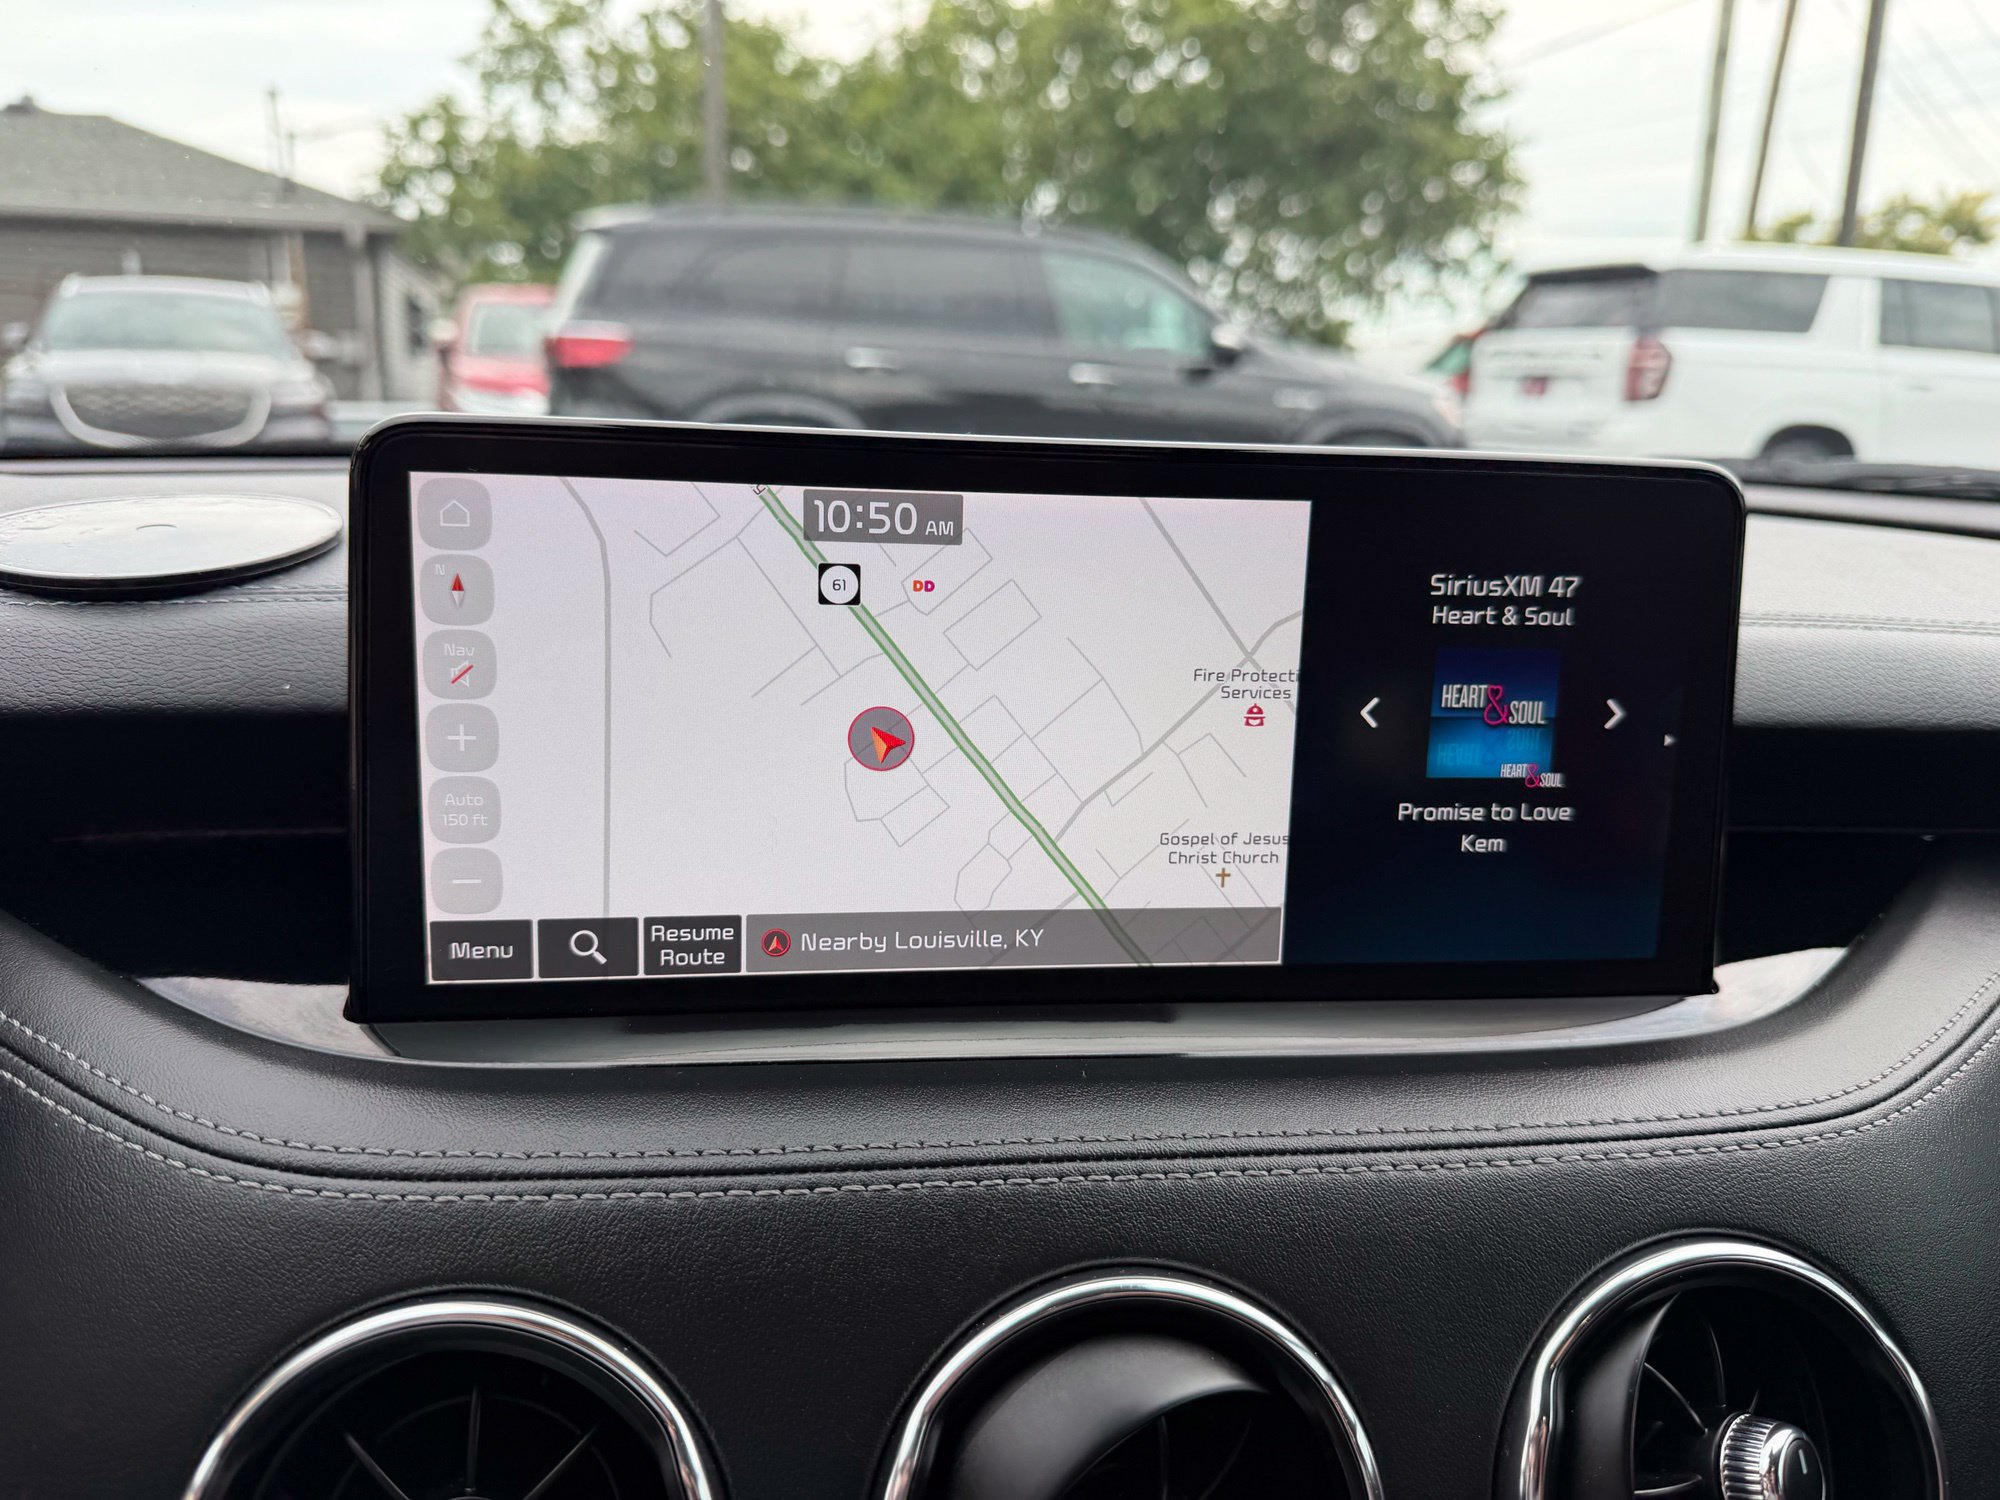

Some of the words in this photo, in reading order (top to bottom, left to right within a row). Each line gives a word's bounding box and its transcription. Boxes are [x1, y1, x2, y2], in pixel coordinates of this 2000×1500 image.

[813, 499, 918, 535] 10:50
[925, 520, 954, 536] AM
[435, 564, 446, 576] N
[832, 578, 846, 591] 61
[912, 579, 936, 593] DD
[1430, 573, 1545, 598] SiriusXM
[1547, 575, 1583, 599] 47
[1431, 604, 1499, 626] Heart
[1501, 605, 1519, 626] &
[1523, 606, 1577, 627] Soul
[444, 643, 475, 656] Nav
[1193, 668, 1226, 683] Fire
[1220, 685, 1292, 700] Services
[1441, 684, 1488, 709] HEART
[1482, 684, 1509, 726] &
[1508, 701, 1549, 725] SOUL
[1500, 763, 1528, 778] HEART
[1524, 763, 1541, 788] &
[1539, 773, 1566, 788] SOUL
[444, 793, 484, 807] Auto
[441, 813, 469, 827] 150
[472, 813, 489, 827] ft
[1397, 802, 1487, 823] Promise
[1490, 803, 1517, 823] to
[1520, 803, 1576, 823] Love
[1159, 832, 1216, 848] Gospel
[1220, 832, 1239, 846] of
[1242, 832, 1290, 846] Jesus
[1460, 834, 1508, 853] Kem
[1168, 851, 1218, 865] Christ
[1222, 851, 1279, 864] Church
[650, 924, 735, 943] Resume
[800, 931, 888, 953] Nearby
[894, 930, 1009, 951] Louisville,
[1014, 928, 1045, 947] KY
[450, 942, 514, 960] Menu
[659, 948, 726, 967] Route
